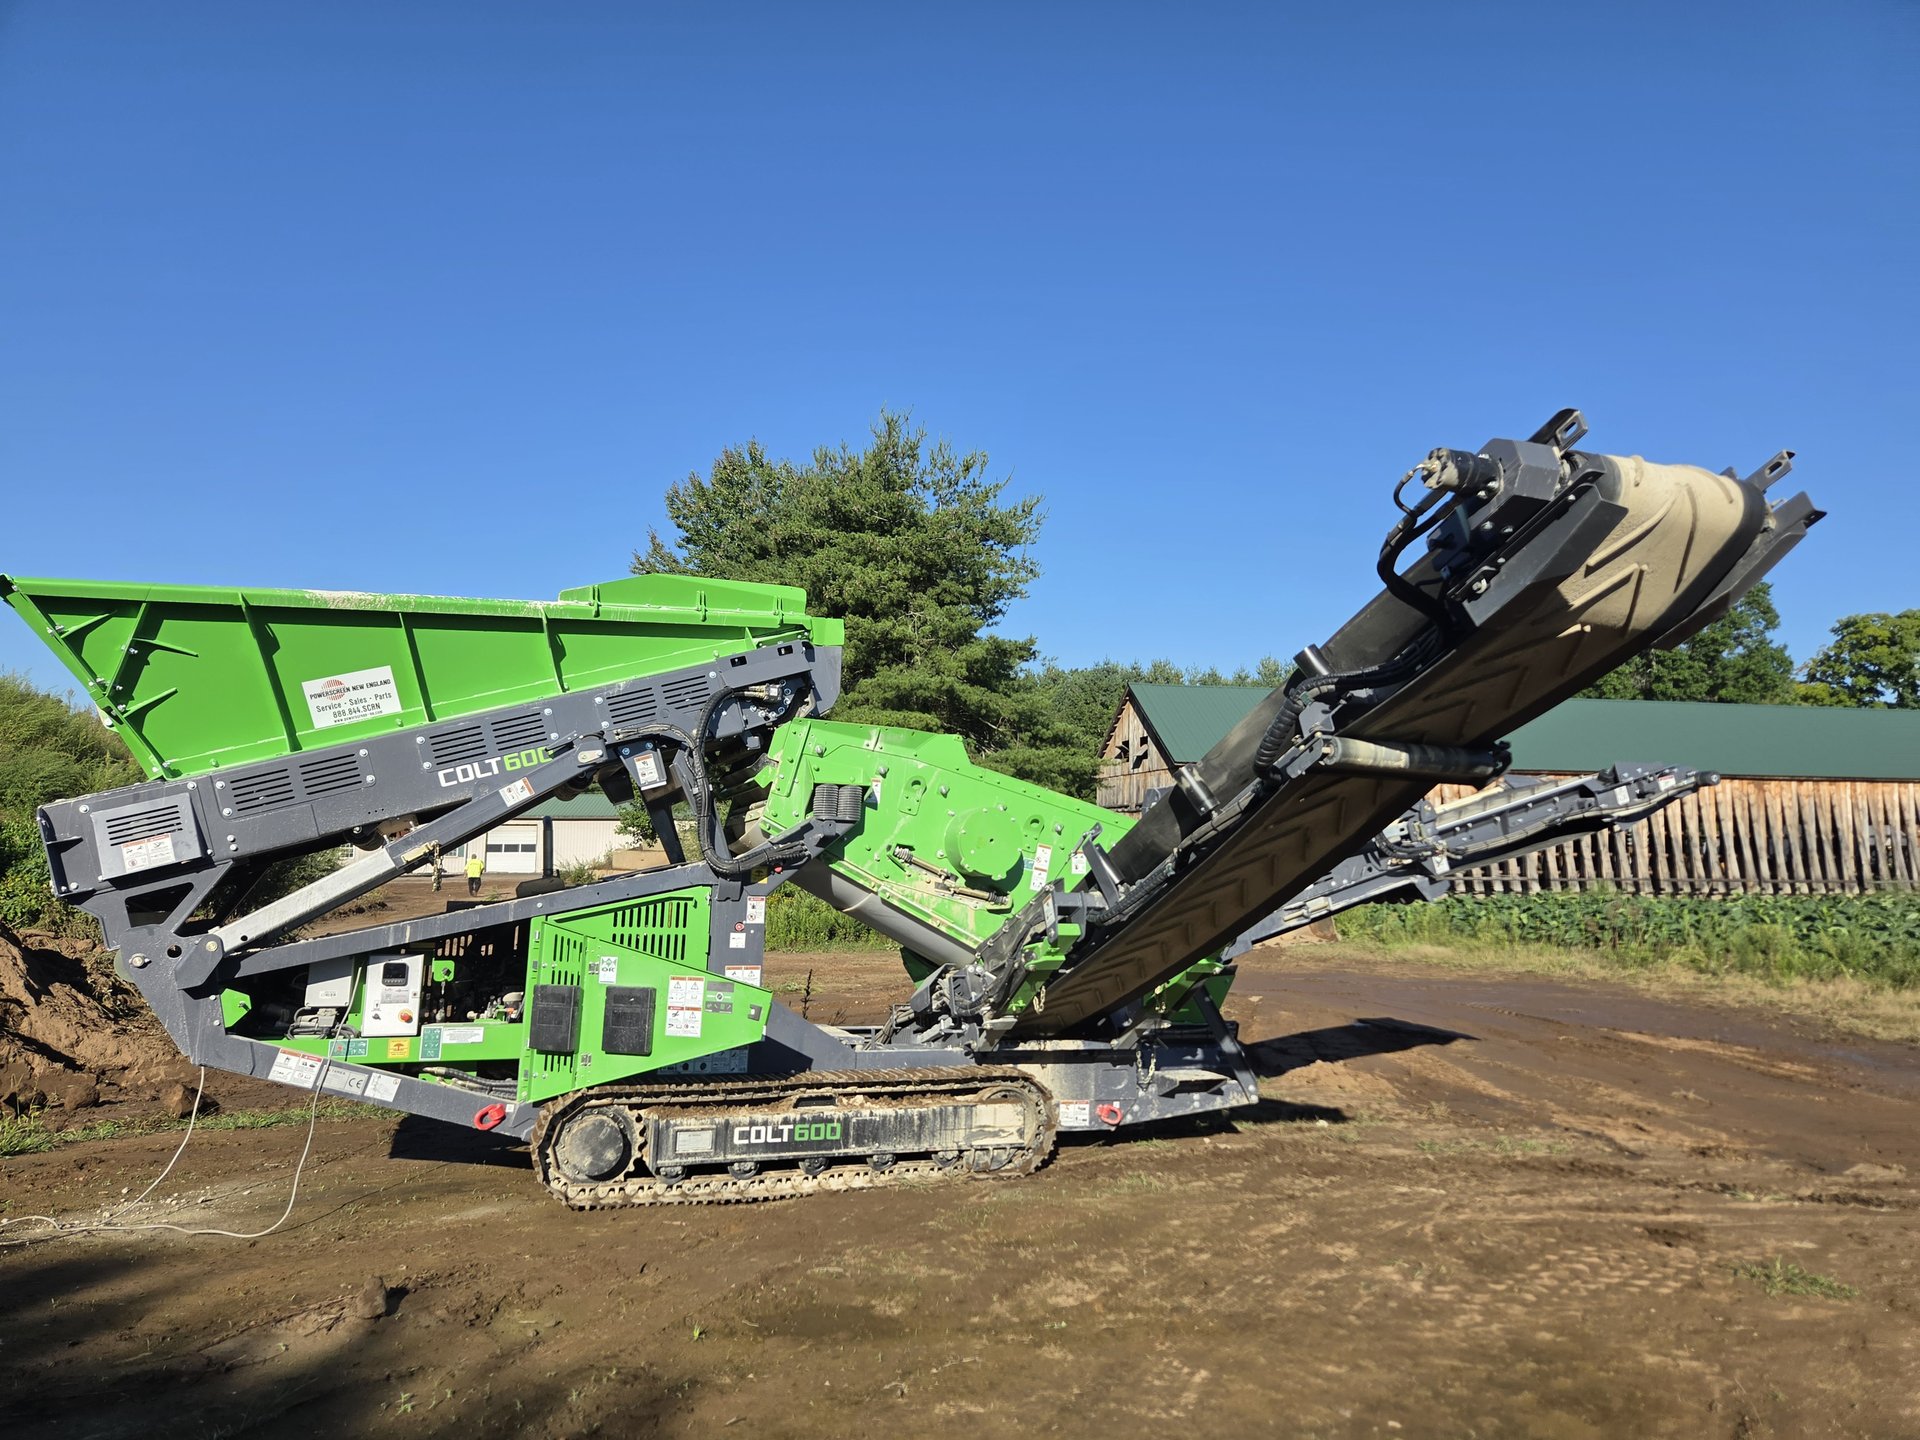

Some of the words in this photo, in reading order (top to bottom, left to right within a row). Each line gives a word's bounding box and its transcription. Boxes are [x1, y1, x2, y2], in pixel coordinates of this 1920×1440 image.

[309, 686, 351, 700] POWERSCREEN
[352, 683, 365, 692] NEW
[366, 678, 391, 689] ENGLAND
[316, 702, 342, 713] Service
[348, 696, 368, 706] Sales
[374, 692, 392, 701] Parts
[332, 702, 381, 719] 888.844.SCRN
[733, 1122, 842, 1145] COLT600
